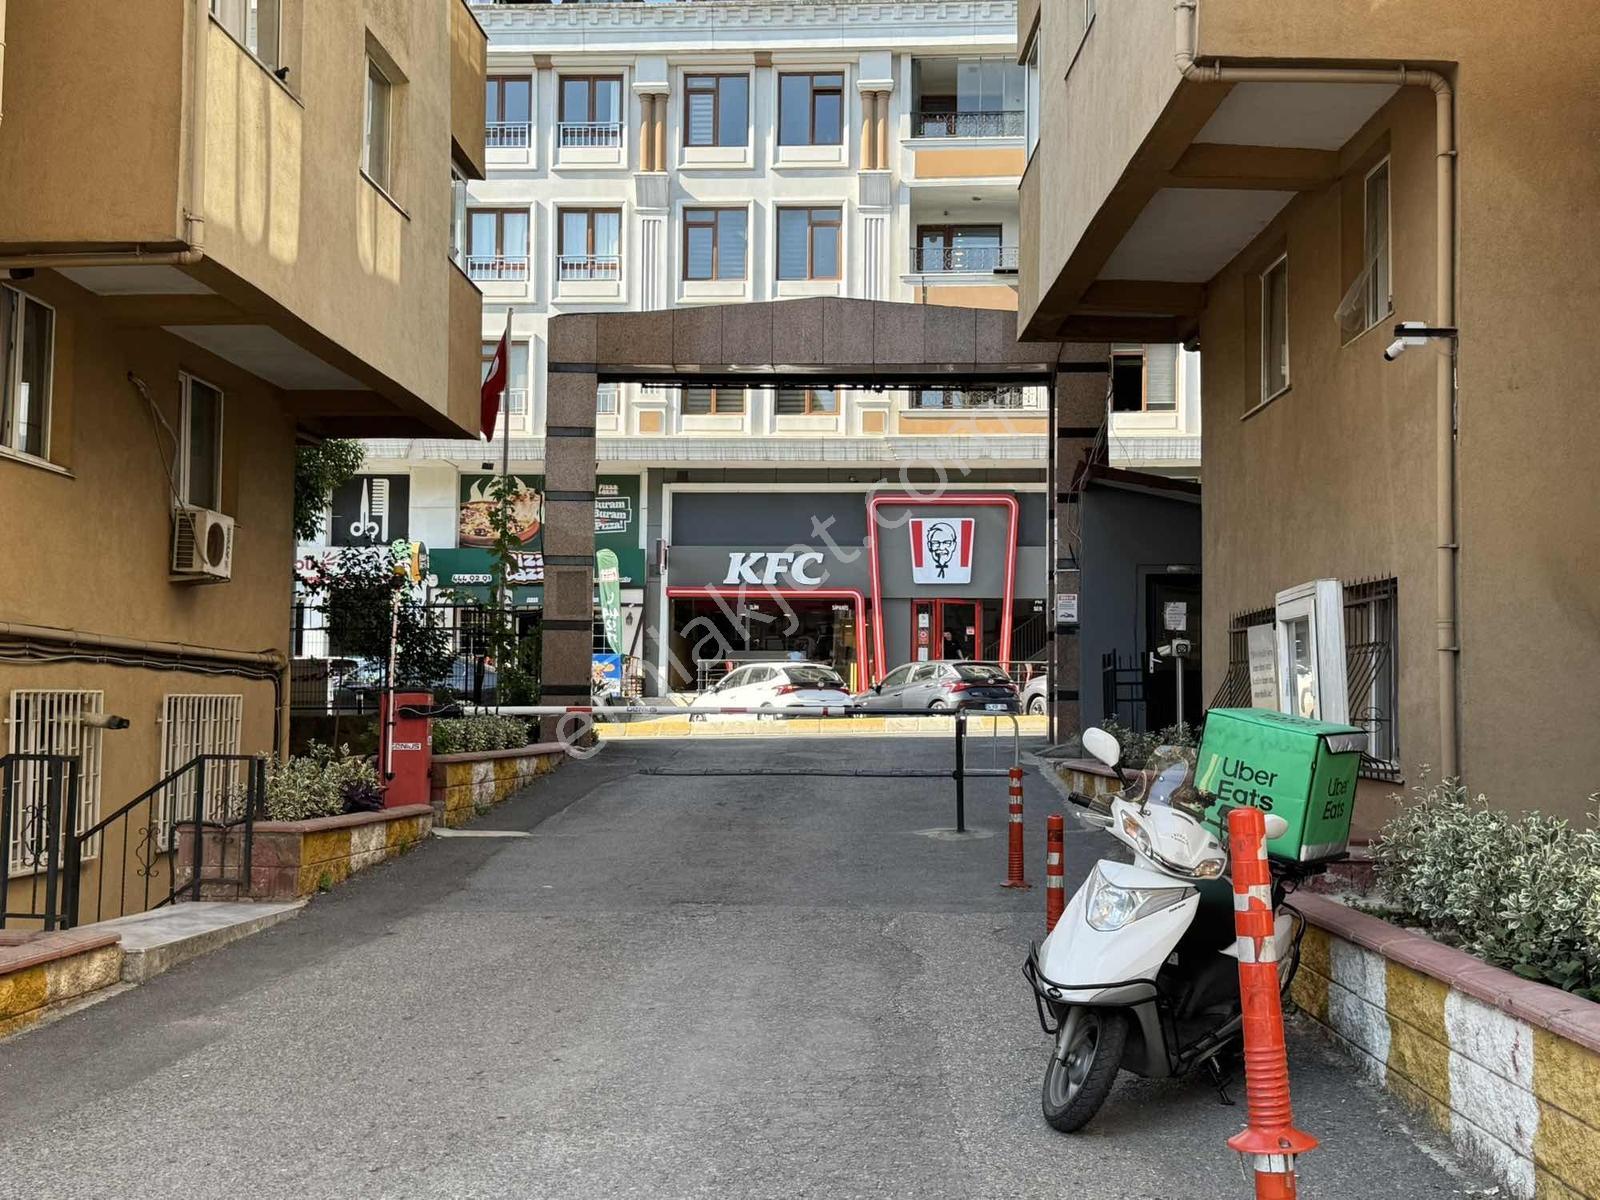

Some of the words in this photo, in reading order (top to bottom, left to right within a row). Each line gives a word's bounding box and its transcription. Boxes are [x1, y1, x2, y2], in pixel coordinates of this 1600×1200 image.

[722, 552, 824, 585] KFC
[1222, 757, 1278, 787] Uber
[1327, 777, 1350, 797] Uber
[1217, 780, 1274, 812] Eats
[1323, 800, 1345, 821] Eats
